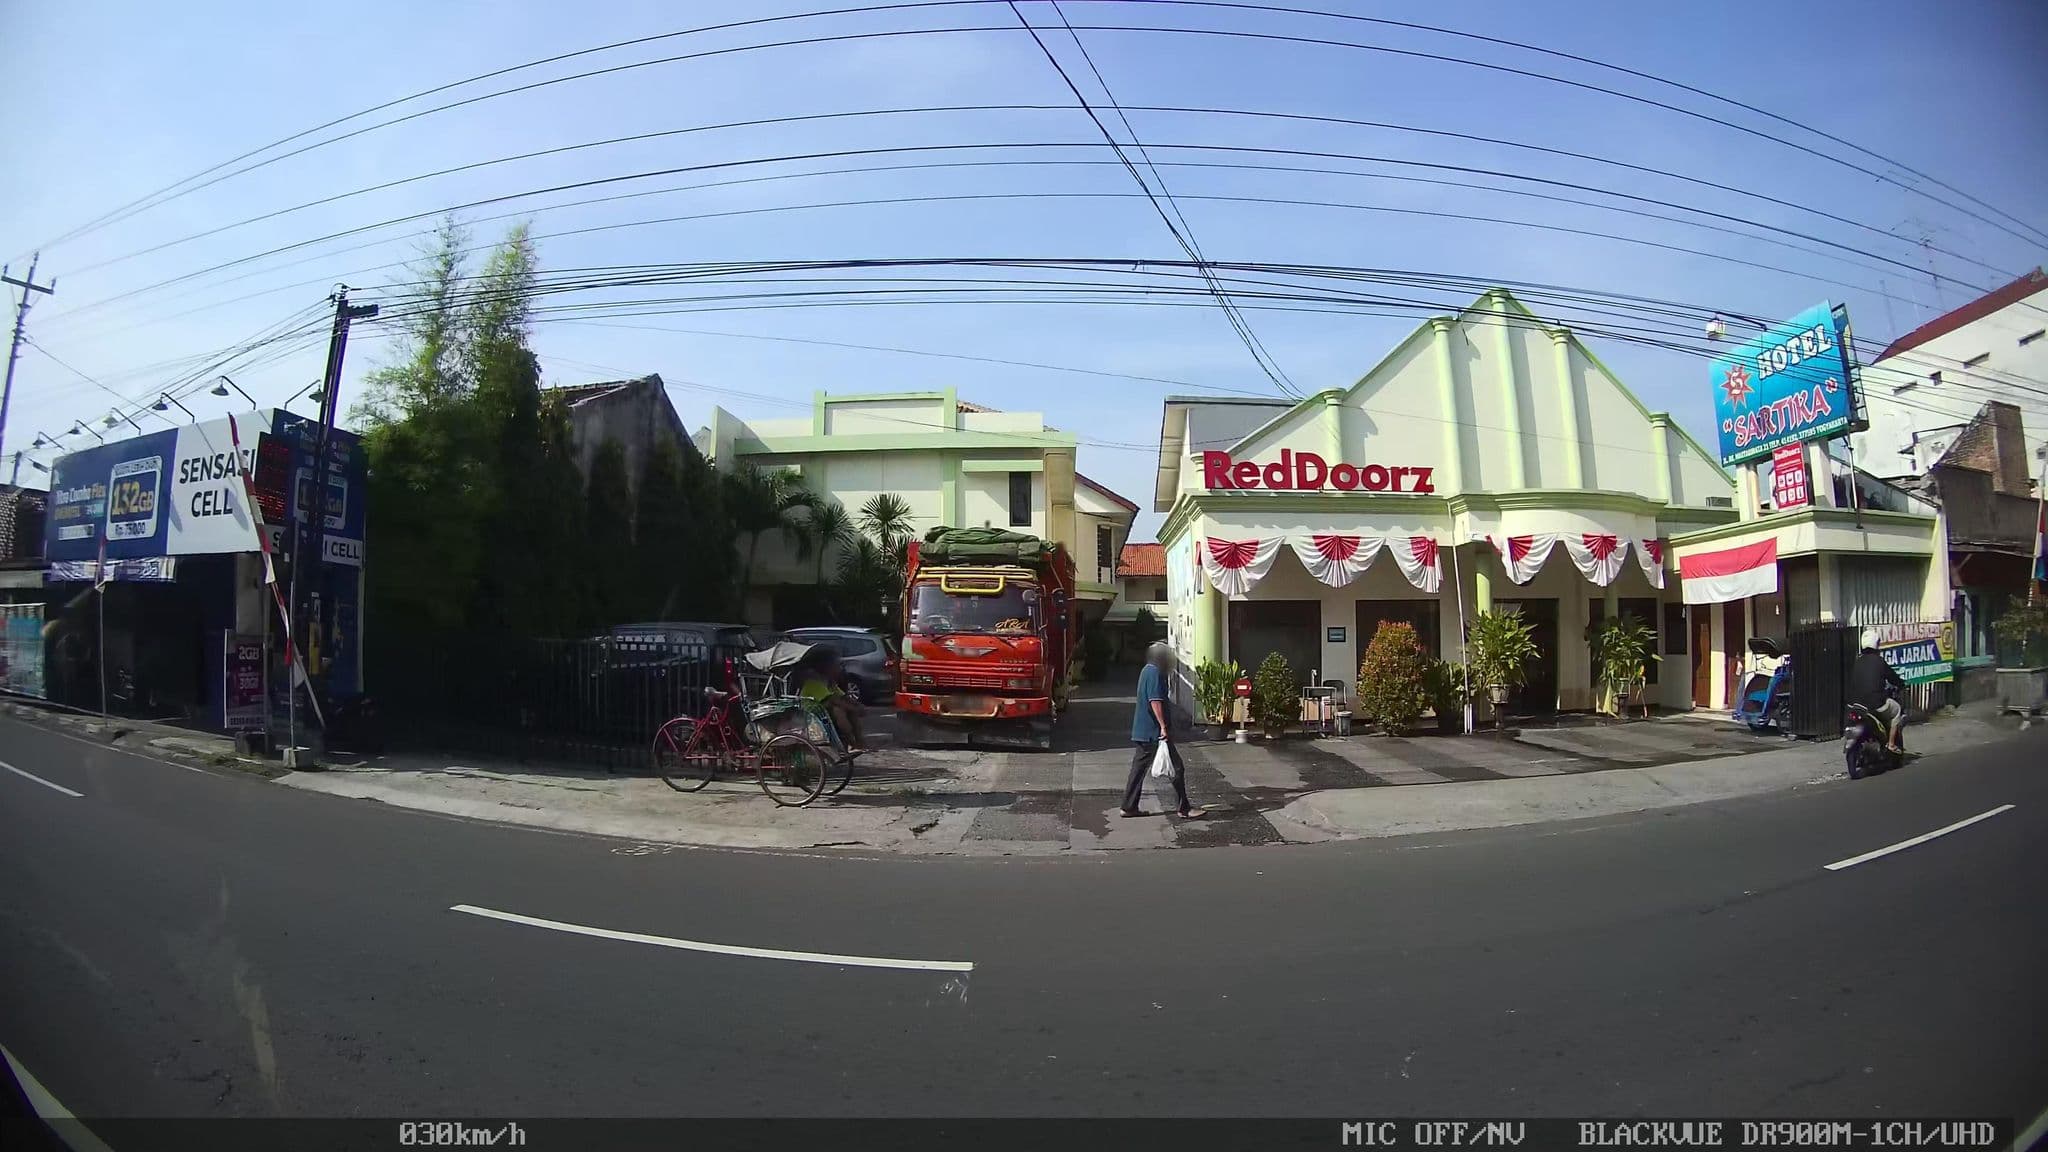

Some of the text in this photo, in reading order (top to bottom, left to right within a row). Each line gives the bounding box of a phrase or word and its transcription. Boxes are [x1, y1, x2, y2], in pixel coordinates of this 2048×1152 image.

[1756, 323, 1832, 380] HOTEL
[1203, 448, 1434, 493] RedDoorz
[191, 488, 233, 517] CELL
[331, 541, 360, 560] CELL
[1900, 643, 1936, 664] JARAK
